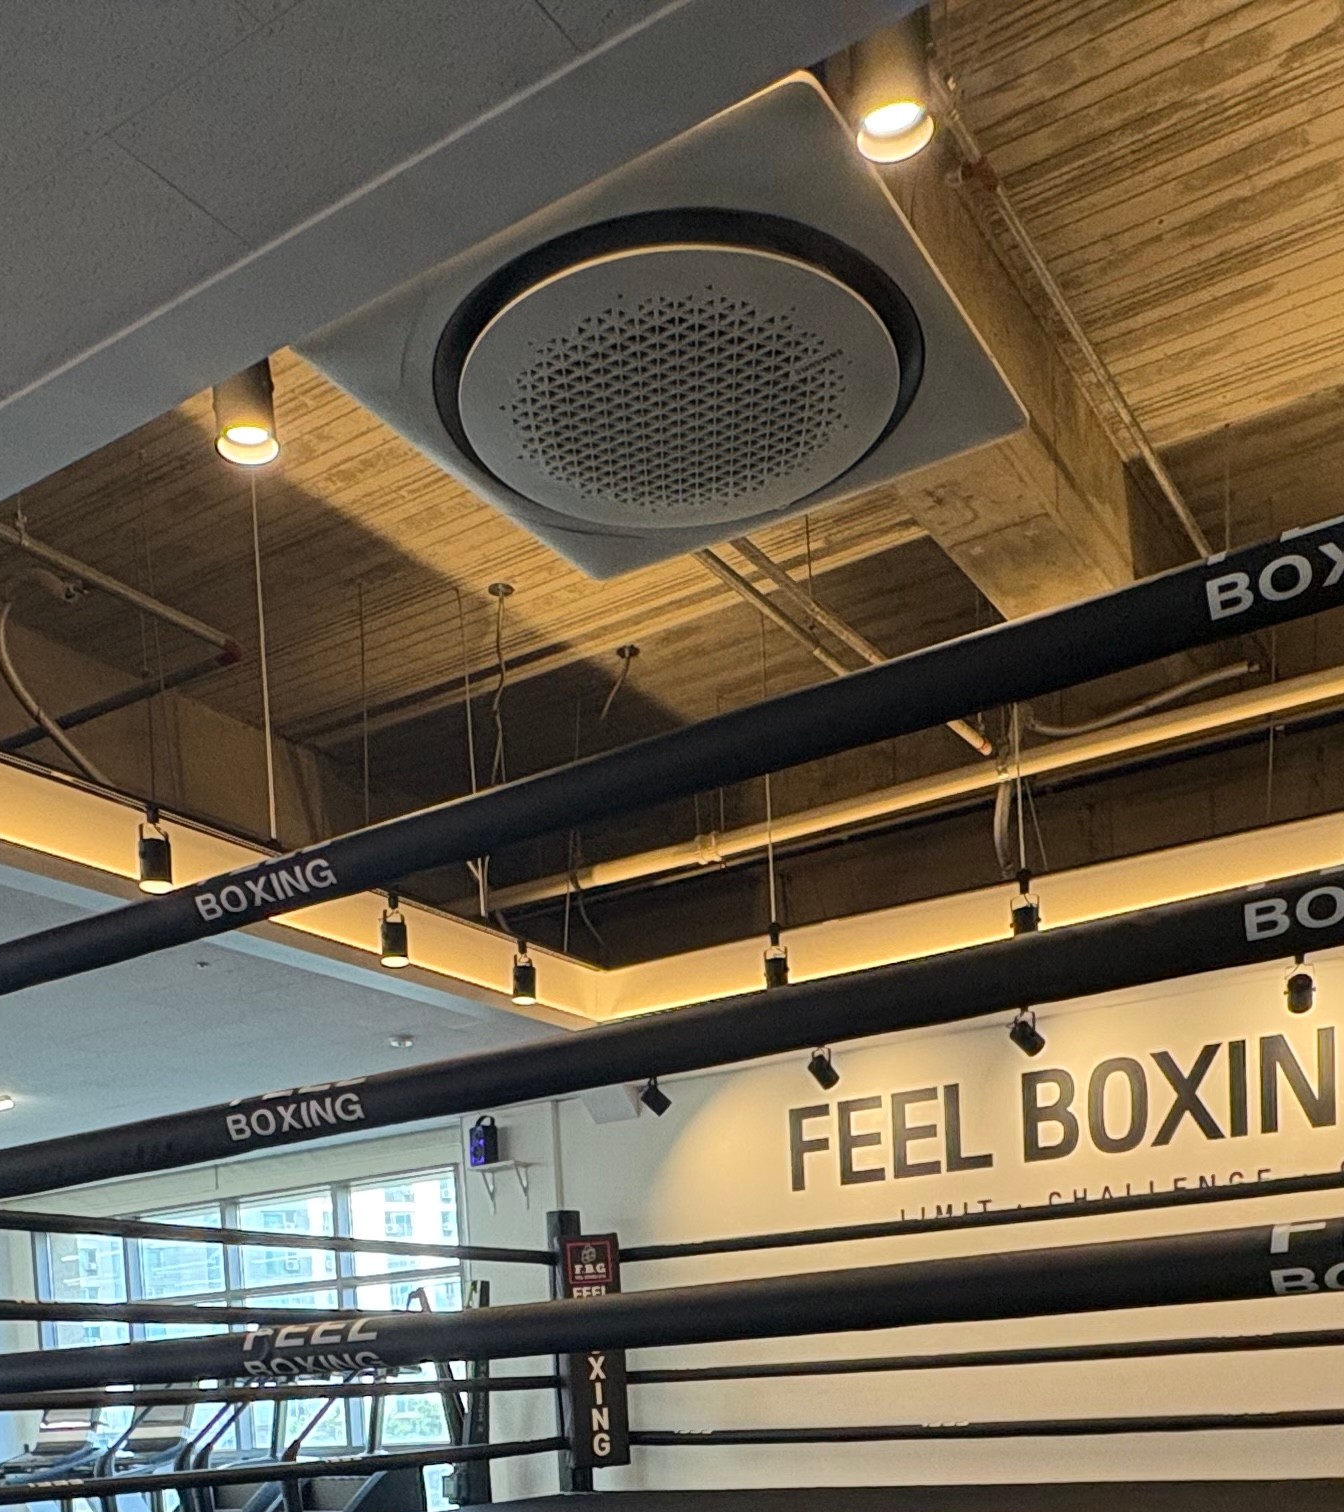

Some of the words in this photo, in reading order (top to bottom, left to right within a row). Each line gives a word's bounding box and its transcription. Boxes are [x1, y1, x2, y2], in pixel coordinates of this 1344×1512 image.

[194, 857, 337, 922] BOXING
[225, 1092, 366, 1142] BOXING
[788, 1082, 993, 1193] FEEL
[243, 1351, 389, 1377] BOXING
[588, 1350, 611, 1457] XING
